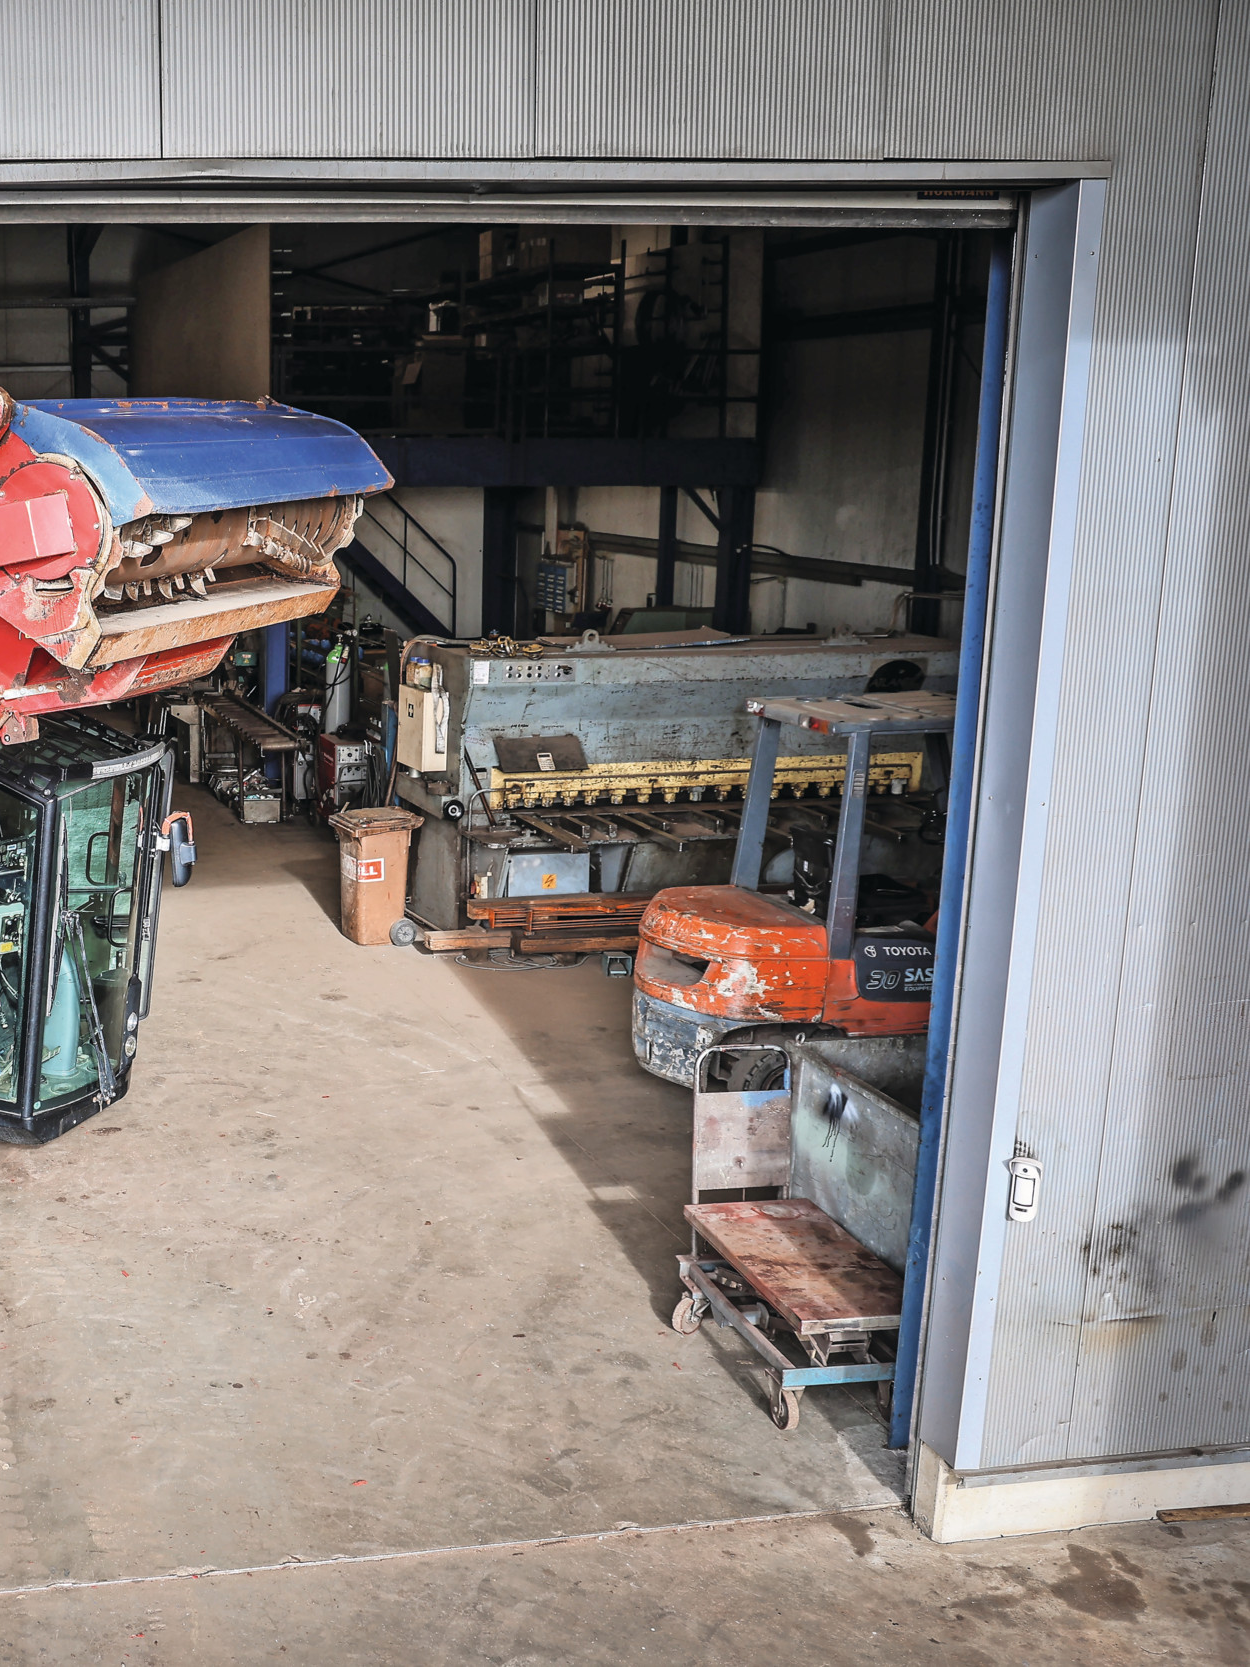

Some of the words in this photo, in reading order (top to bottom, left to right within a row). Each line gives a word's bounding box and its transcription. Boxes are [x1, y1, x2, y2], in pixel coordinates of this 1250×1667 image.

[882, 946, 932, 956] TOYOTA
[866, 969, 901, 990] 30
[904, 967, 934, 983] SAS
